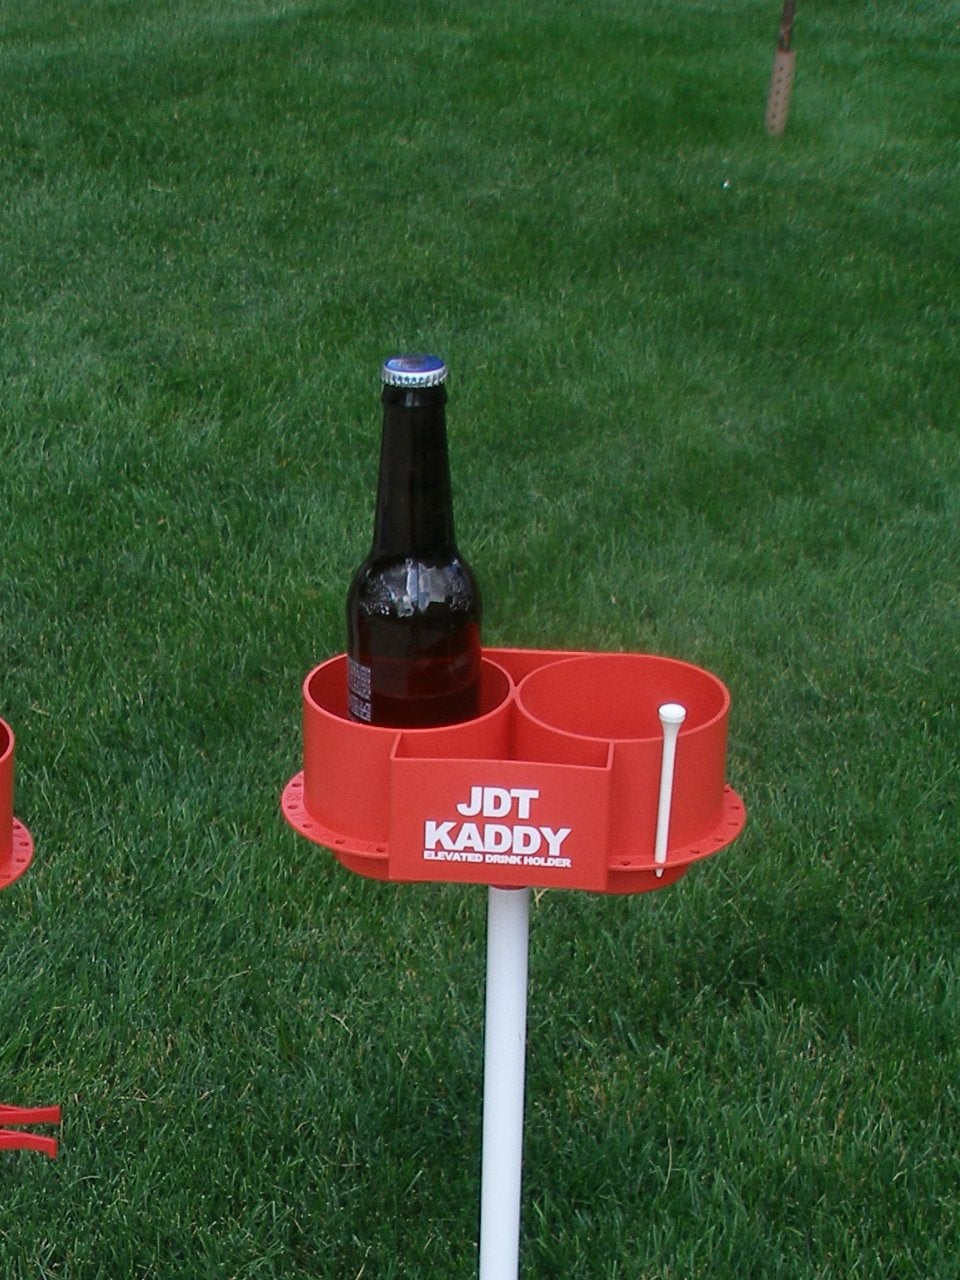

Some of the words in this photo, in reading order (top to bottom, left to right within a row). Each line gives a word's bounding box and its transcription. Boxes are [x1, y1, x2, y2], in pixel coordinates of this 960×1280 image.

[456, 786, 539, 819] JDT
[424, 820, 572, 856] KADDY
[424, 852, 483, 862] ELEVATED
[485, 853, 522, 865] DRINK
[523, 856, 572, 868] HOLDER
